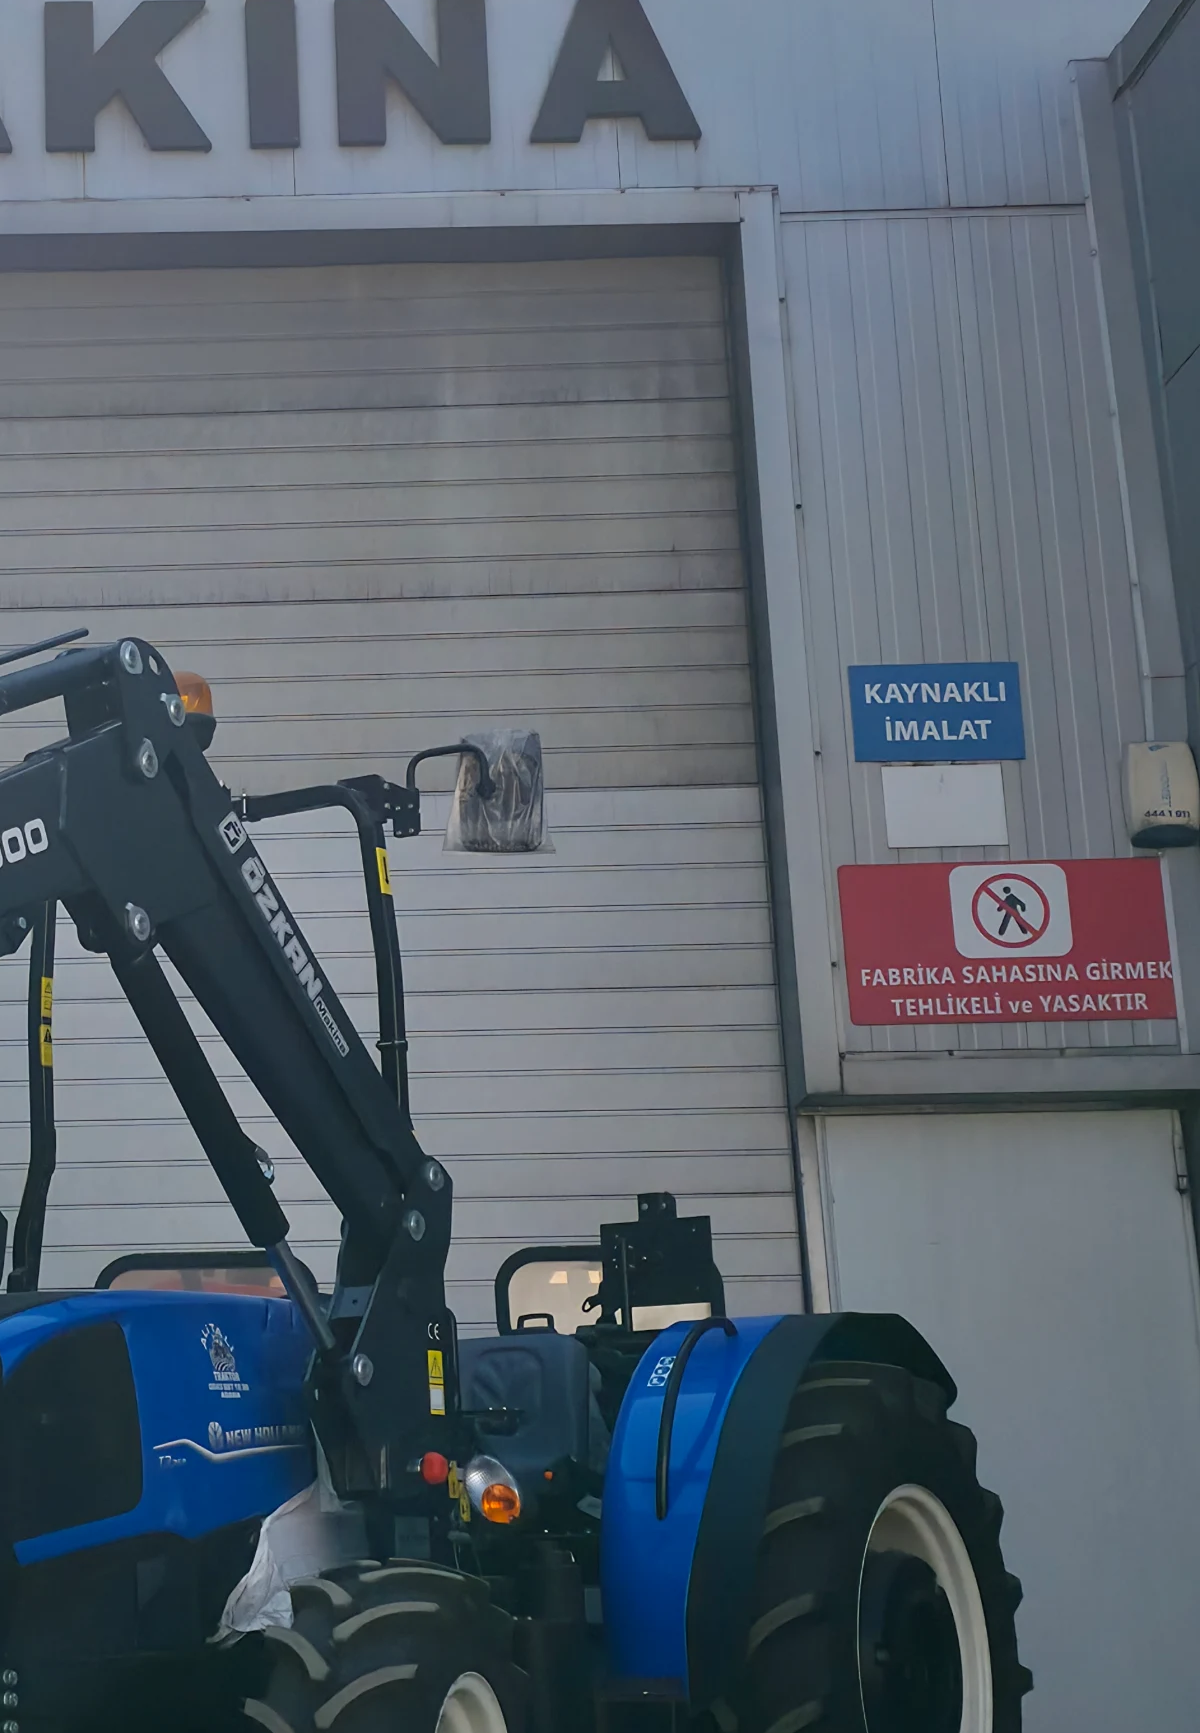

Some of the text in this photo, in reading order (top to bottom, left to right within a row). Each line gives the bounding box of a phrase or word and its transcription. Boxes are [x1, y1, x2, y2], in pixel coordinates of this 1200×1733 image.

[864, 681, 1007, 705] KAYNAKLI
[885, 716, 992, 742] İMALAT
[241, 856, 349, 1057] ÖZKAN Makina
[860, 958, 1173, 987] FABRİKA SAHASINA GİRMEK
[890, 992, 1149, 1017] TEHLİKELİ ve YASAKTIR
[427, 1322, 441, 1341] CE
[225, 1428, 252, 1447] NEW
